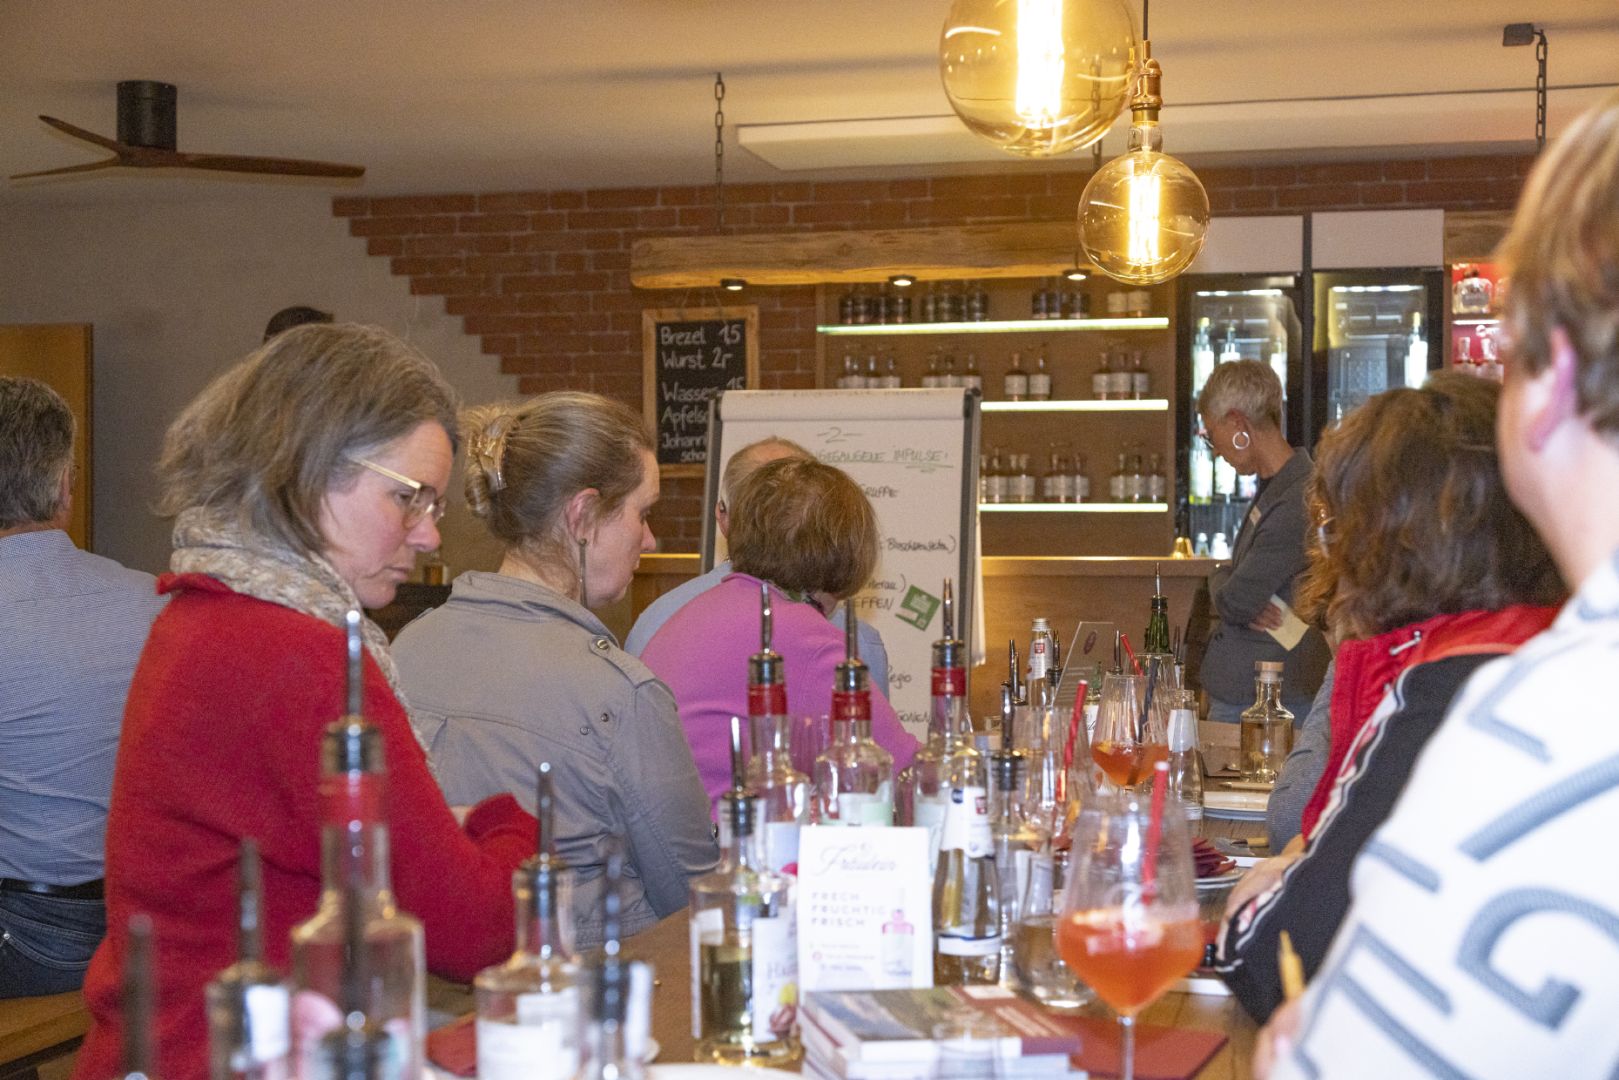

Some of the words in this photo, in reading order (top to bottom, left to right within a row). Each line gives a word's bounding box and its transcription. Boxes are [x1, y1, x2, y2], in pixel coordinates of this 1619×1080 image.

[660, 325, 706, 346] Brezel
[661, 348, 706, 369] Wurst
[845, 597, 895, 611] EFFEN
